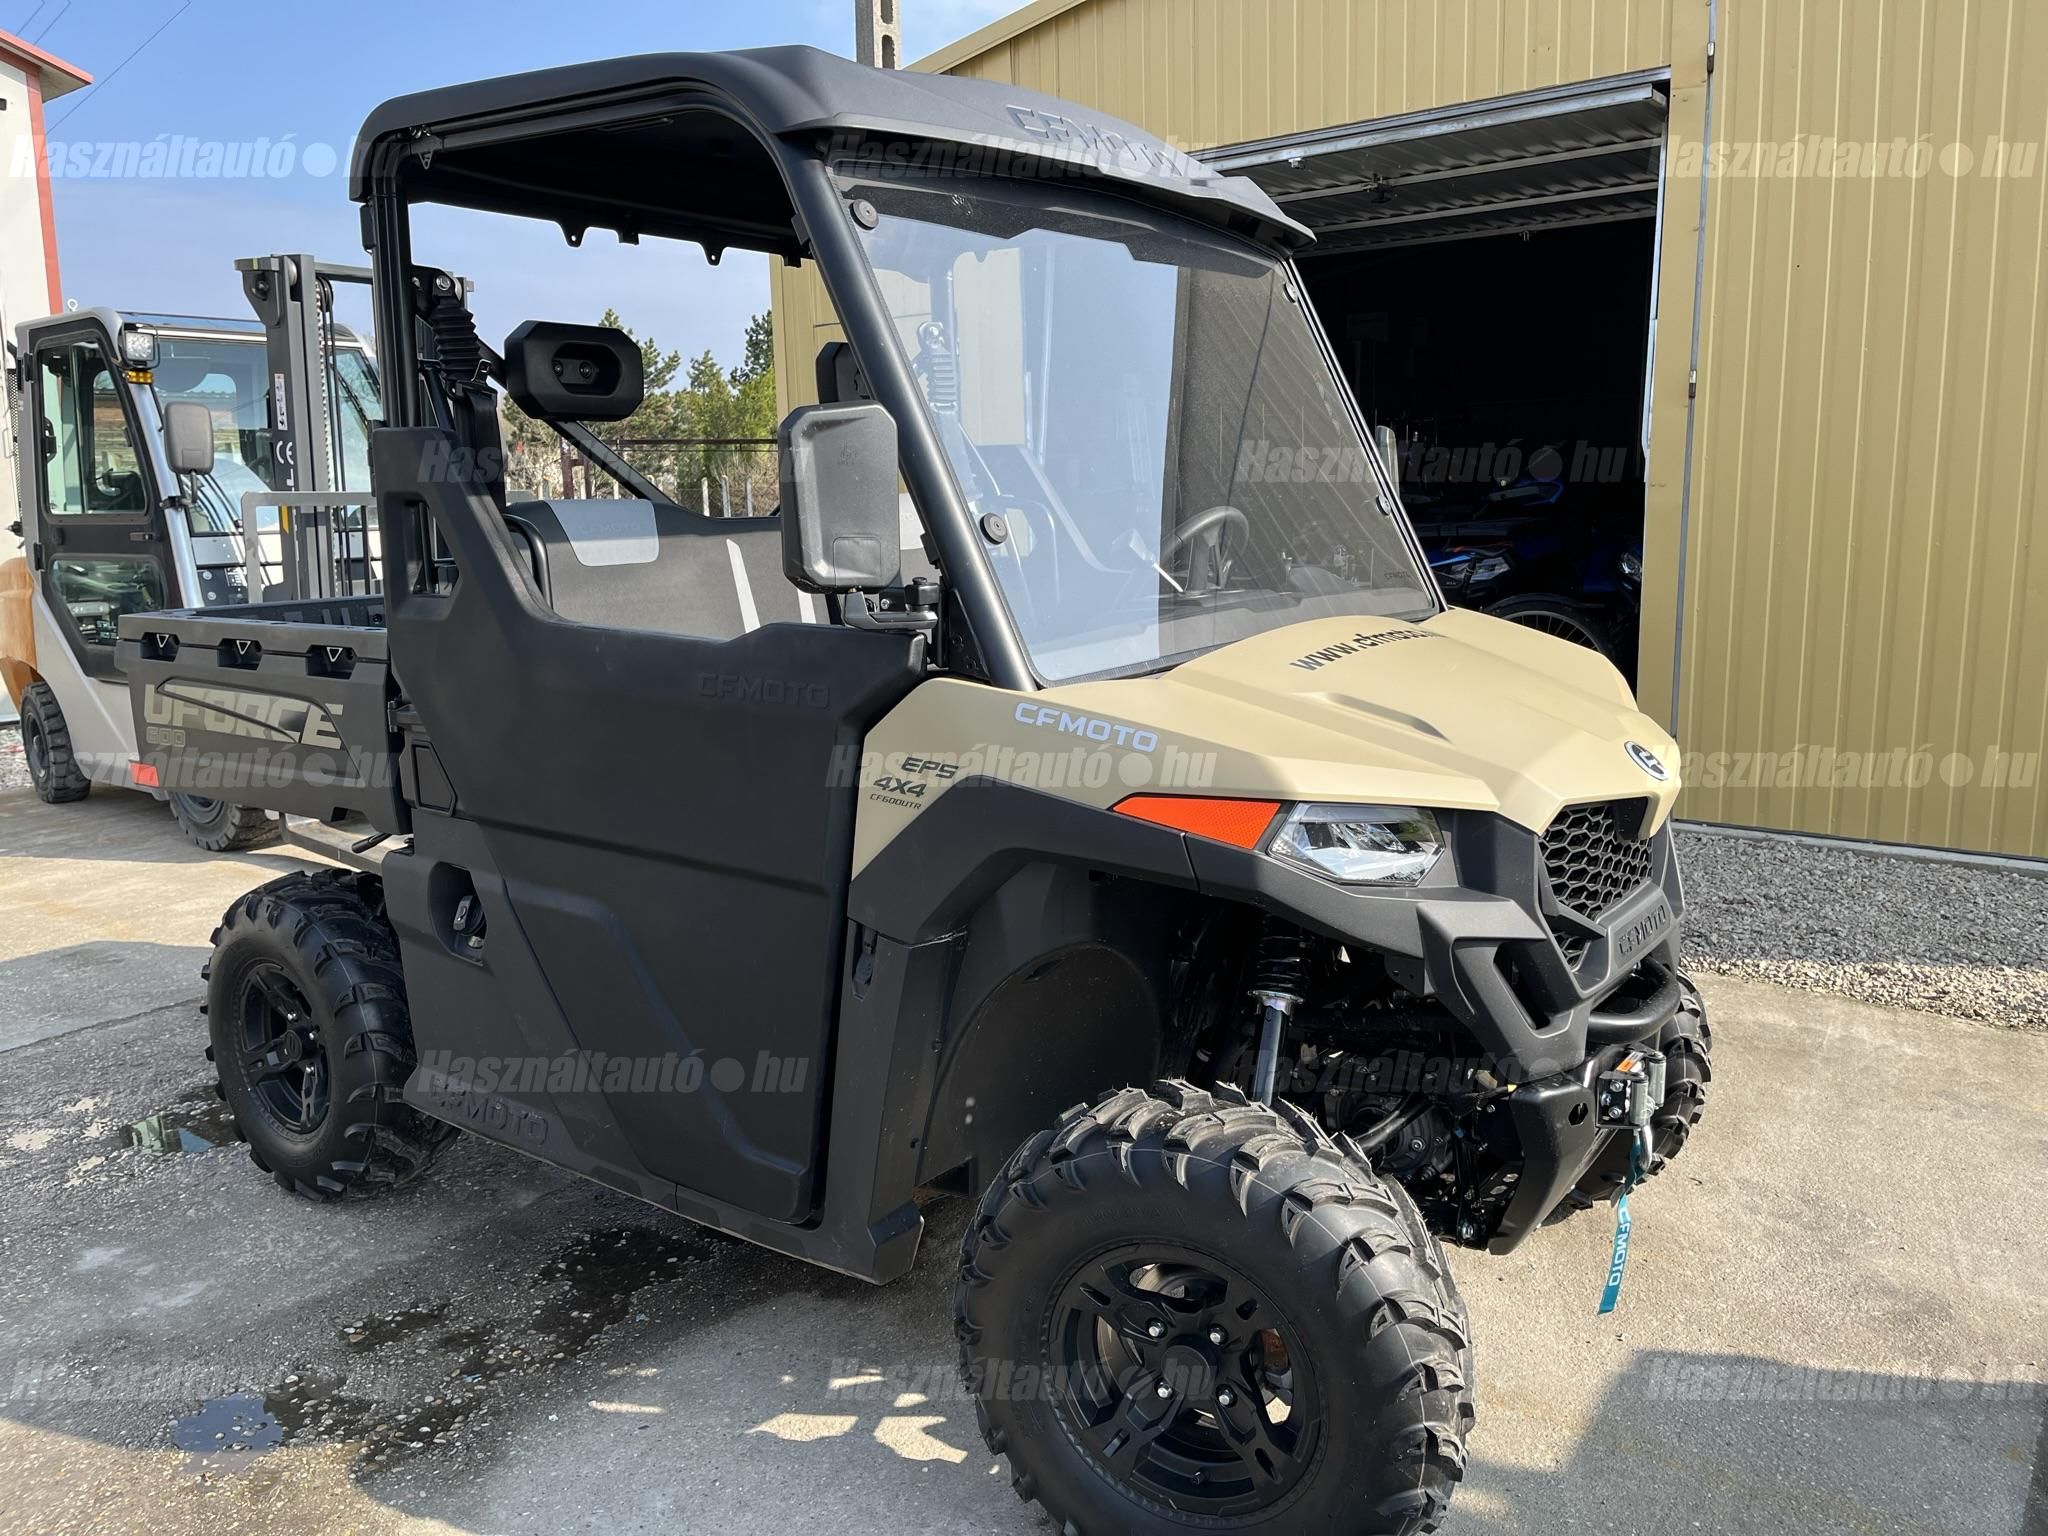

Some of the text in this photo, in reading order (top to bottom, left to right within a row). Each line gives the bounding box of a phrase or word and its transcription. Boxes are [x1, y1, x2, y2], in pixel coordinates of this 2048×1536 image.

[698, 672, 831, 709] CFMOTO
[144, 683, 344, 749] UFORCE
[1014, 702, 1158, 752] CFMOTO
[901, 756, 959, 779] EPS
[870, 793, 922, 810] CF600UTR
[1617, 905, 1667, 954] CFMOTO
[431, 1073, 549, 1145] CFMOTO
[1608, 1206, 1632, 1287] CFMOTO
